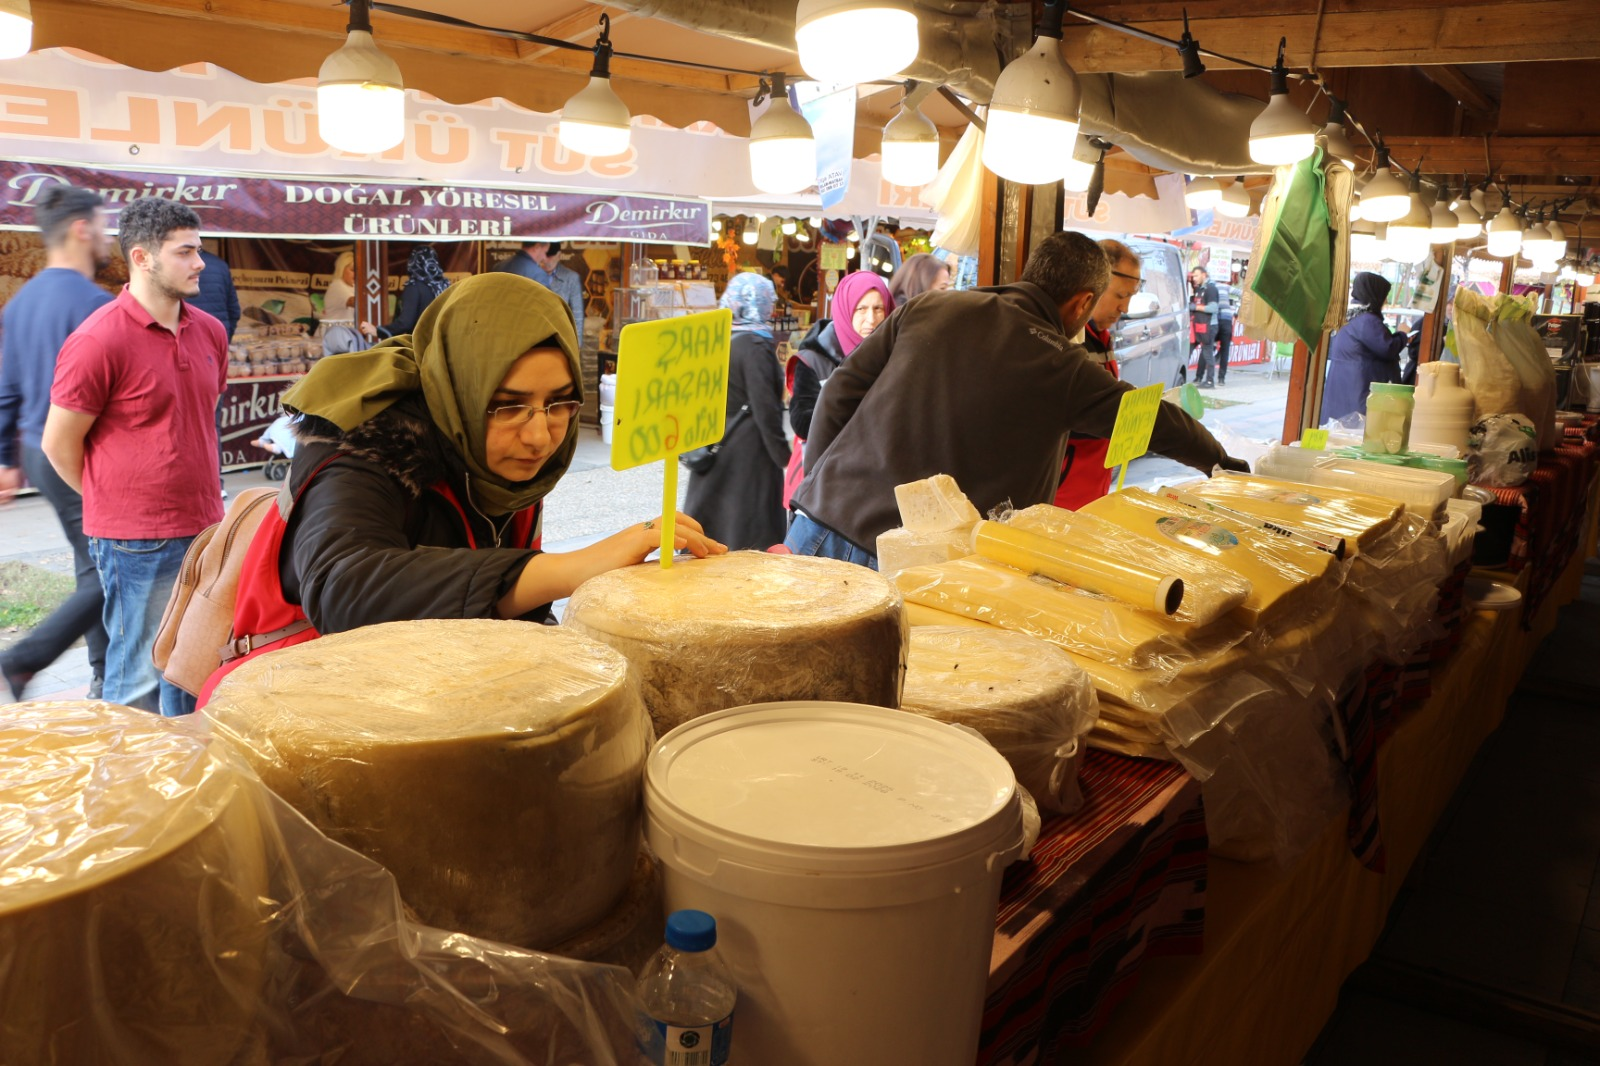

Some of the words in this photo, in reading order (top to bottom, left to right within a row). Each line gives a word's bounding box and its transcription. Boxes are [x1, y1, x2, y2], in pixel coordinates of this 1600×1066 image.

[7, 173, 237, 207] Dmirkır
[285, 183, 411, 207] DOĞAL
[419, 187, 556, 211] YÖRESEL
[343, 214, 512, 236] ÜRÜNLERİ
[585, 200, 701, 227] Demirkır
[630, 230, 668, 240] GIDA
